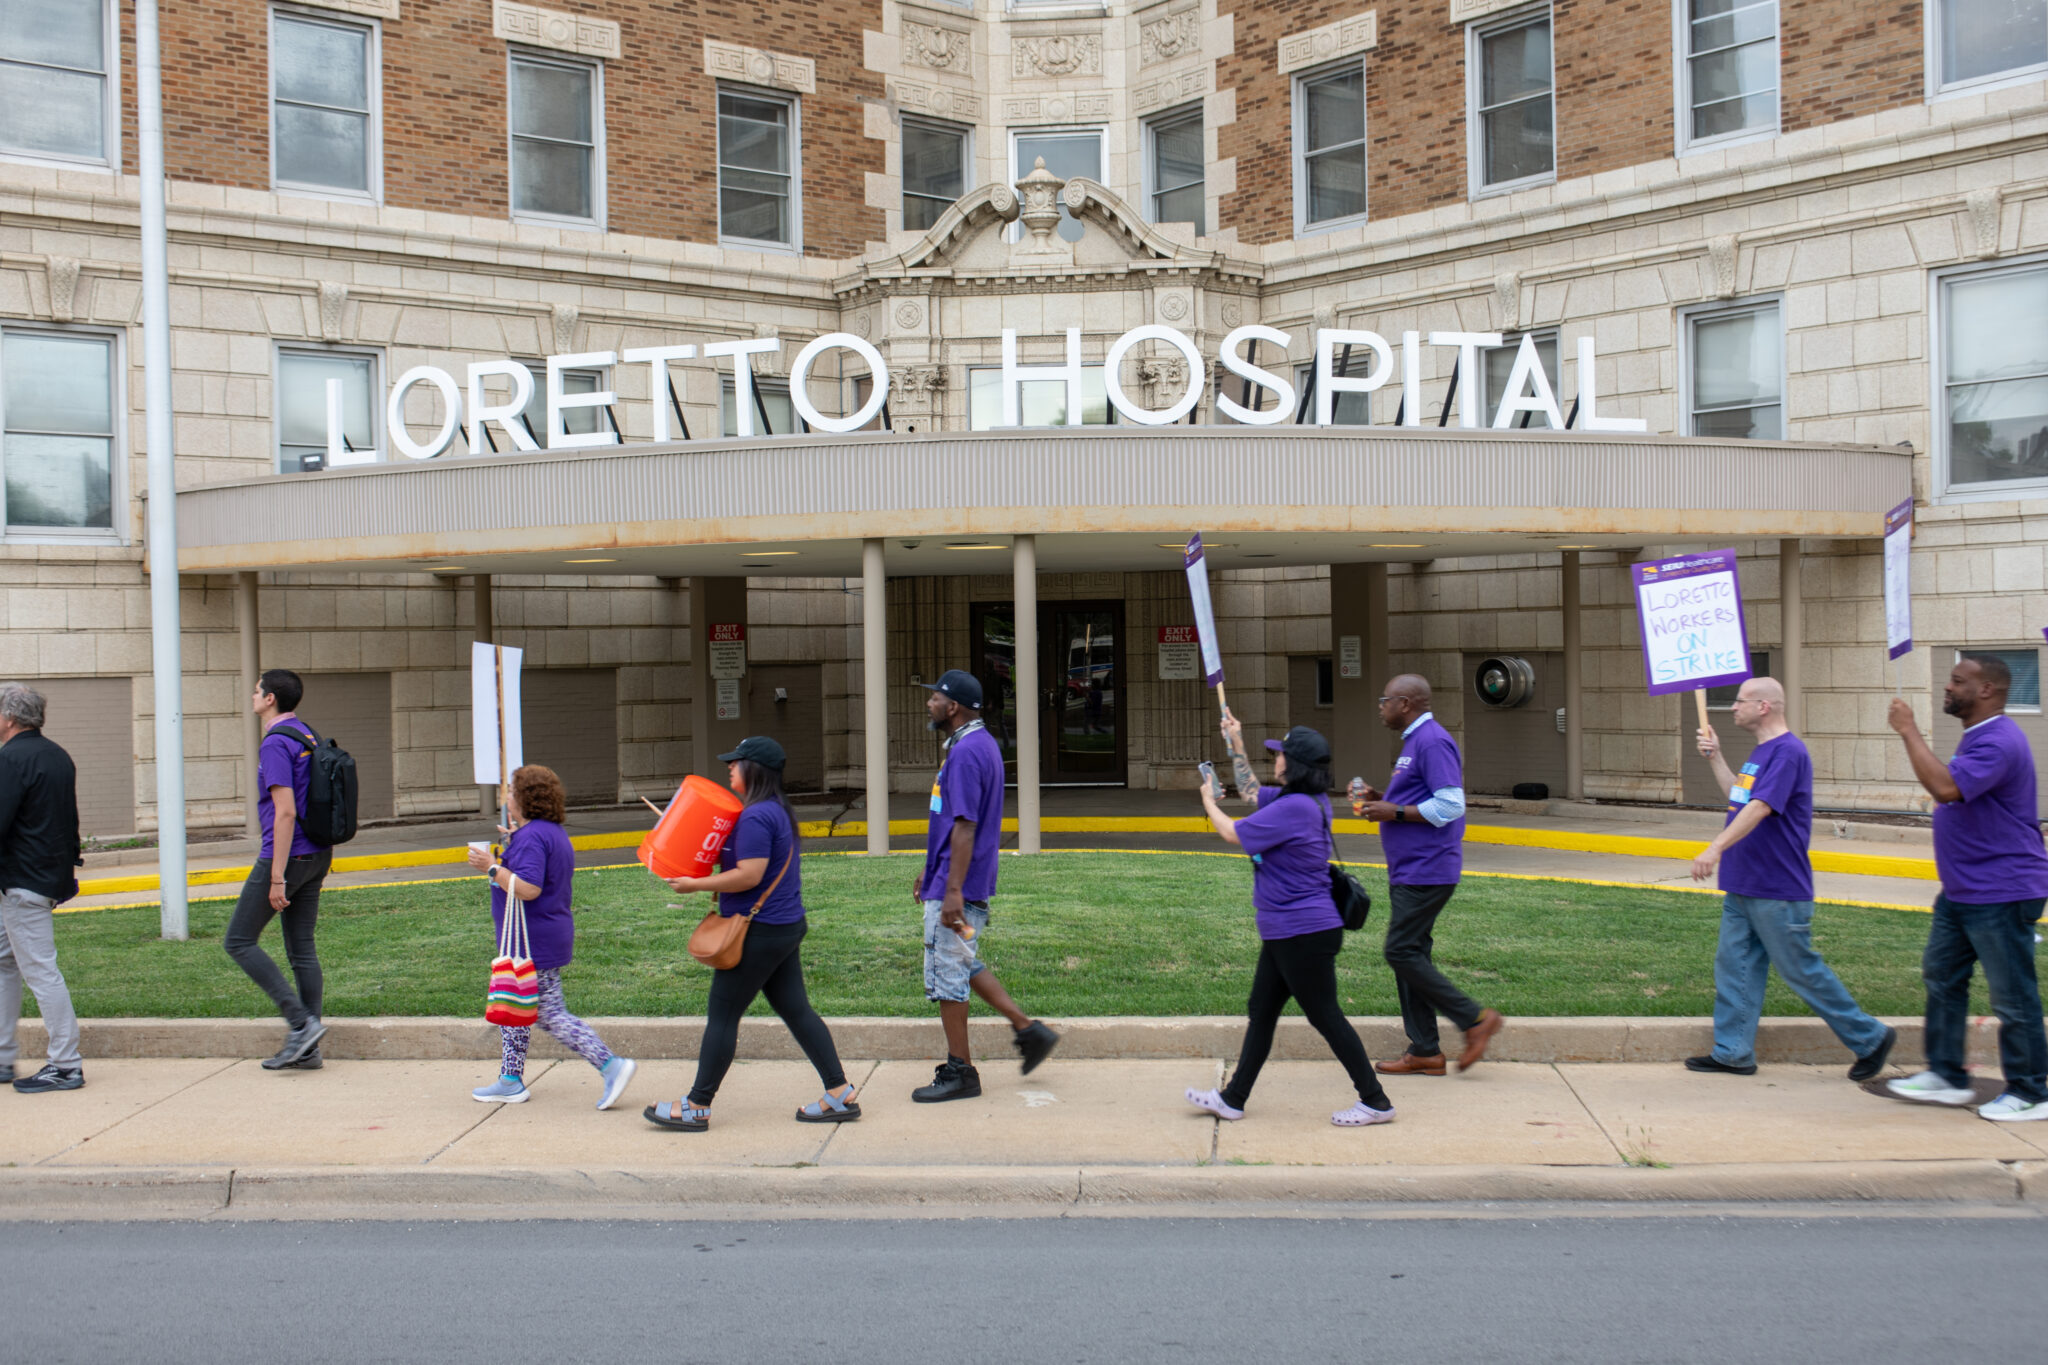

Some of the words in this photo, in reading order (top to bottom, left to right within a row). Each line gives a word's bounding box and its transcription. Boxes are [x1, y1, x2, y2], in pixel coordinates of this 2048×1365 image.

[325, 332, 890, 467] LORETTO
[1000, 323, 1647, 432] HOSPITAL
[714, 632, 739, 640] ONLY
[715, 624, 738, 632] EXIT
[1650, 608, 1735, 638] WORKERS
[1164, 634, 1192, 642] ONLY
[1677, 628, 1707, 654] ON
[1655, 650, 1741, 680] STRIKE
